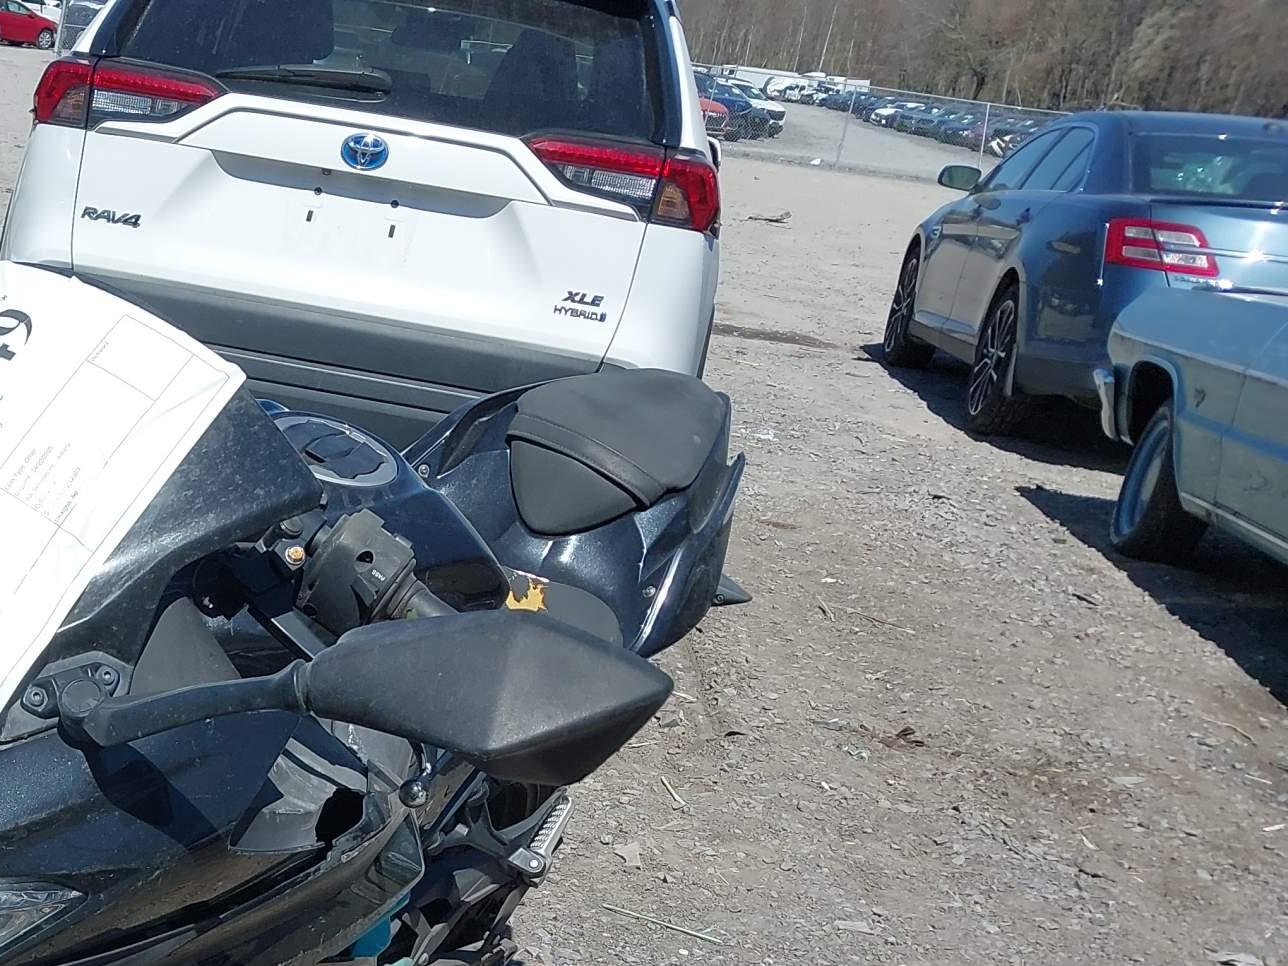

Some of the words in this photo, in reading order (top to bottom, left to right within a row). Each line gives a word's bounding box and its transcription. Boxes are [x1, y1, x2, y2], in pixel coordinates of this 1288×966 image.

[80, 205, 142, 229] RAV4
[560, 290, 605, 307] XLE
[553, 304, 600, 321] HYBRID
